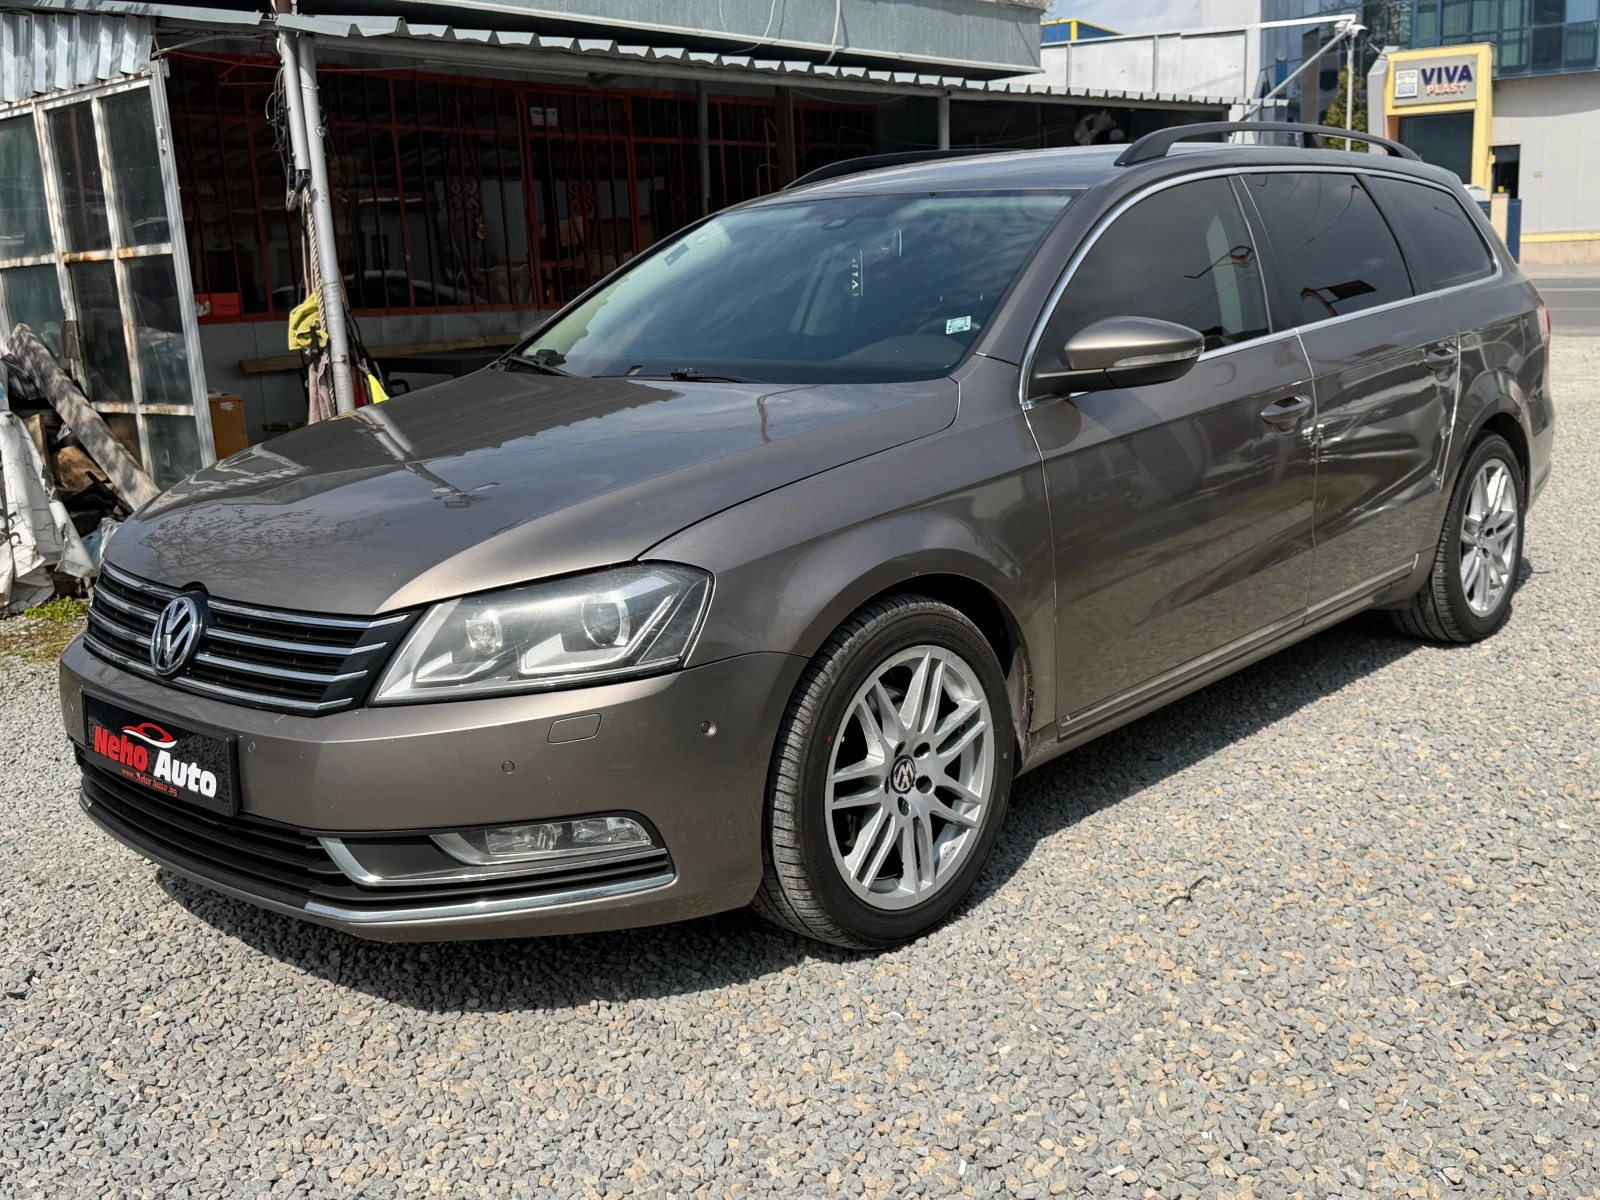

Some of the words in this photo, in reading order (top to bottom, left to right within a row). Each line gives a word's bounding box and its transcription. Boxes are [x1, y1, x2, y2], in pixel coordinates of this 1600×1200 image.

[1421, 65, 1473, 85] VIVA
[1426, 81, 1468, 96] PLAST
[94, 725, 148, 772] Neho
[153, 750, 217, 798] Auto
